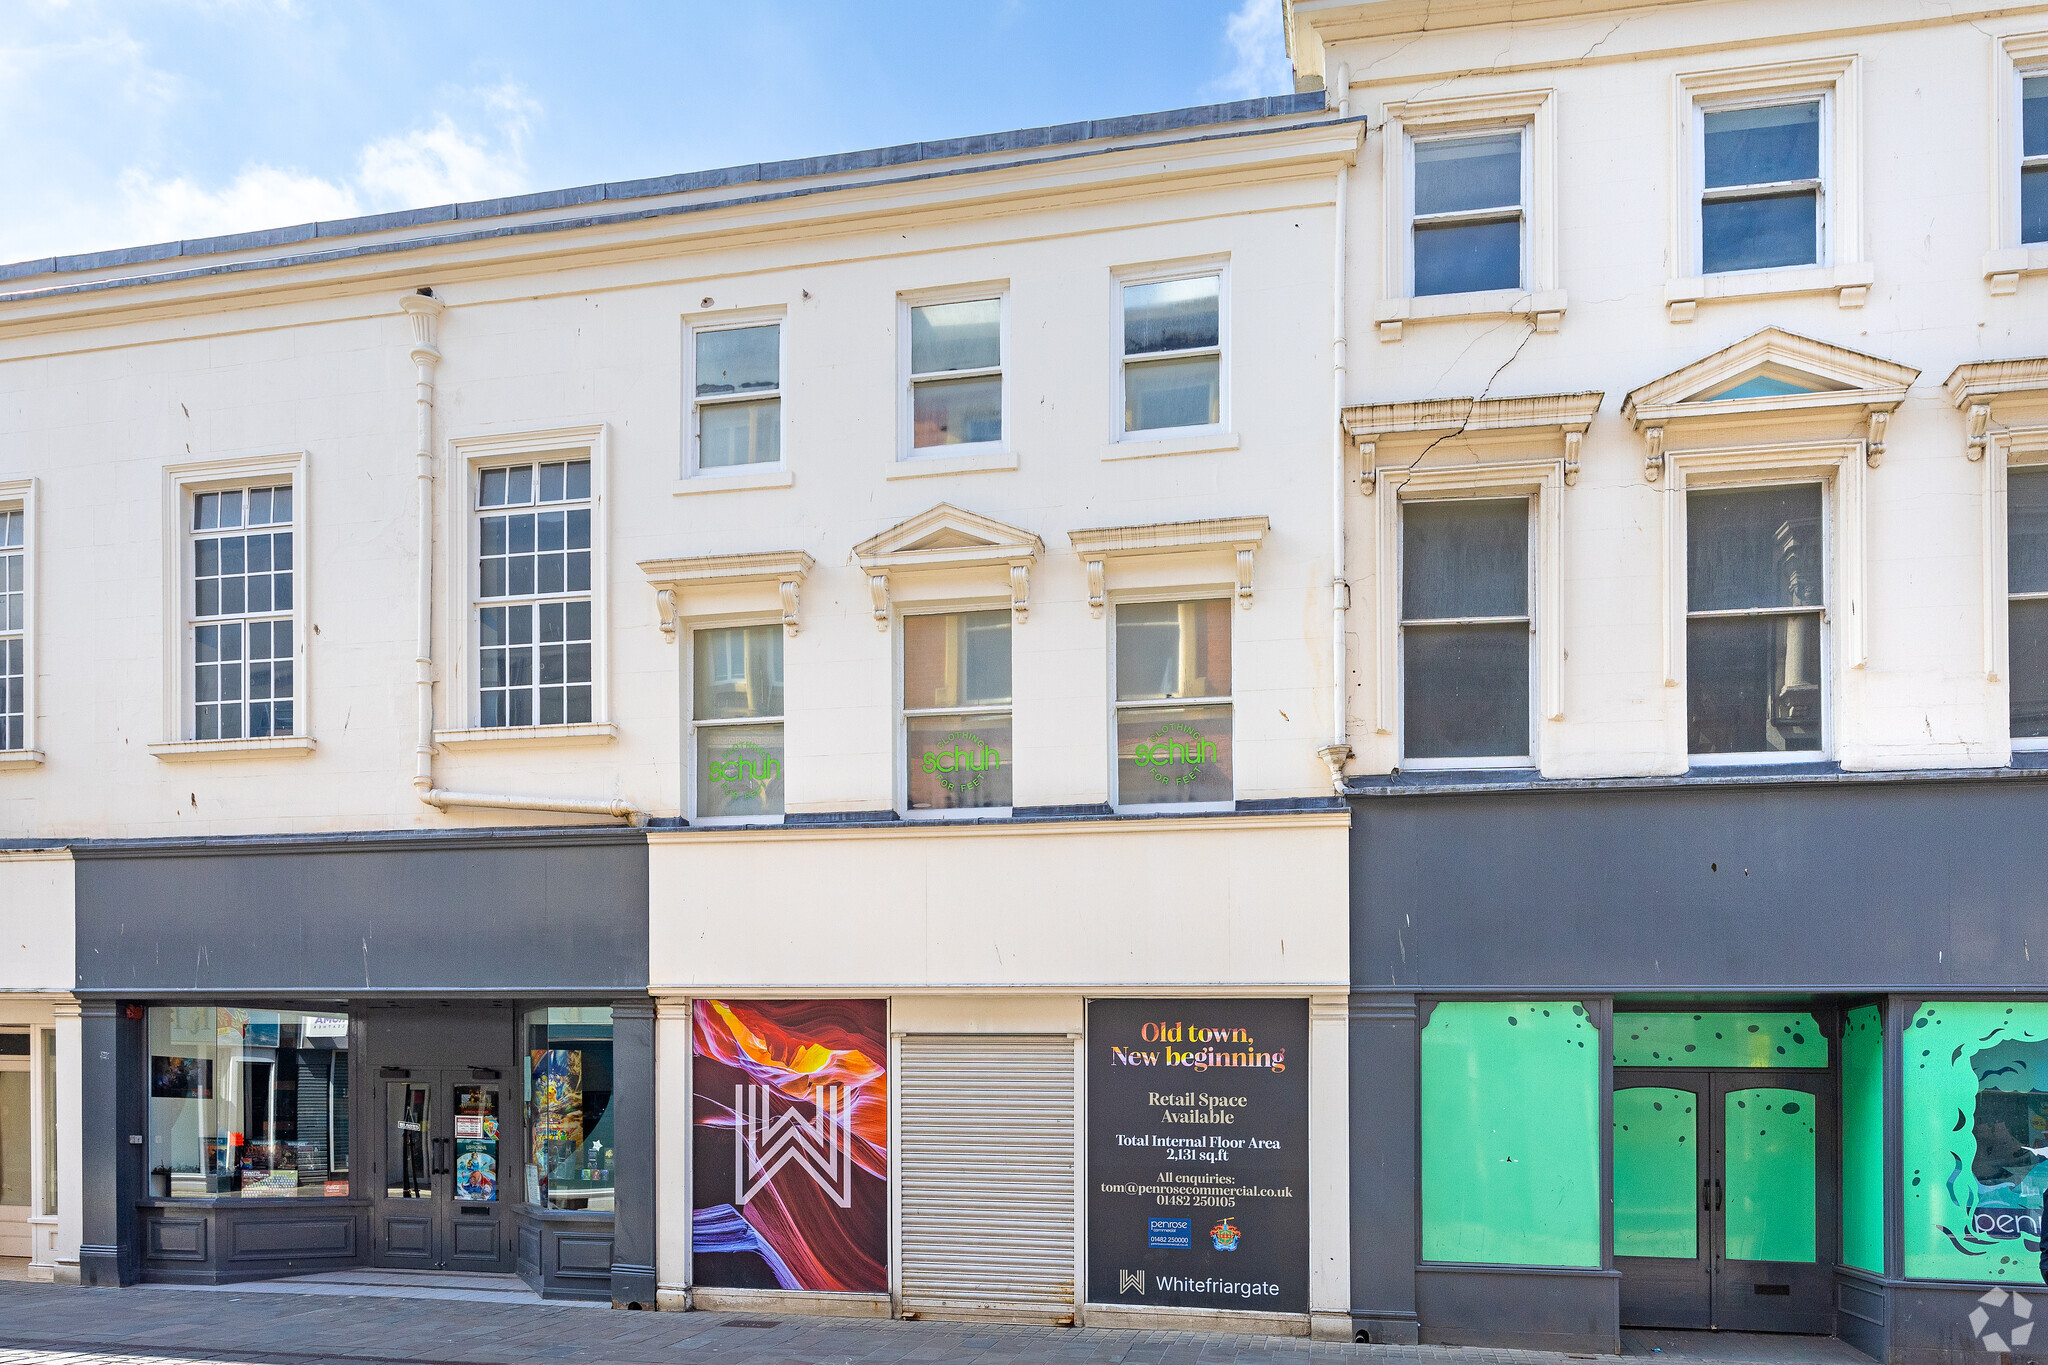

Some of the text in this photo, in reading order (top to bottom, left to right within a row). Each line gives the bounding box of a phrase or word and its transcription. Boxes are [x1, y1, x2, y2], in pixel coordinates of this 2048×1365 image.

[936, 731, 984, 750] CLOTHING
[1150, 723, 1201, 742] CLOTHING
[722, 741, 767, 759] CLOTHING
[922, 744, 1000, 773] schuh
[1134, 736, 1217, 767] schuh
[708, 754, 780, 782] schuh
[1149, 765, 1201, 786] FOR FEET
[935, 772, 985, 792] FOR FEET
[1141, 1021, 1254, 1046] Old town,
[1110, 1045, 1286, 1073] New beginning
[1148, 1091, 1248, 1110] Retail Space
[1161, 1109, 1235, 1124] Available
[1115, 1134, 1281, 1150] Total Internal Floor Area
[1166, 1148, 1230, 1164] 2,131 sq.ft
[1156, 1171, 1236, 1187] All enquiries:
[1100, 1181, 1293, 1198] tom@penrosecommercial.co.uk
[1156, 1194, 1236, 1208] 01482 250105
[1150, 1220, 1188, 1231] penrose
[1150, 1235, 1189, 1244] 01482 250000
[1155, 1275, 1280, 1299] Whitefriargate
